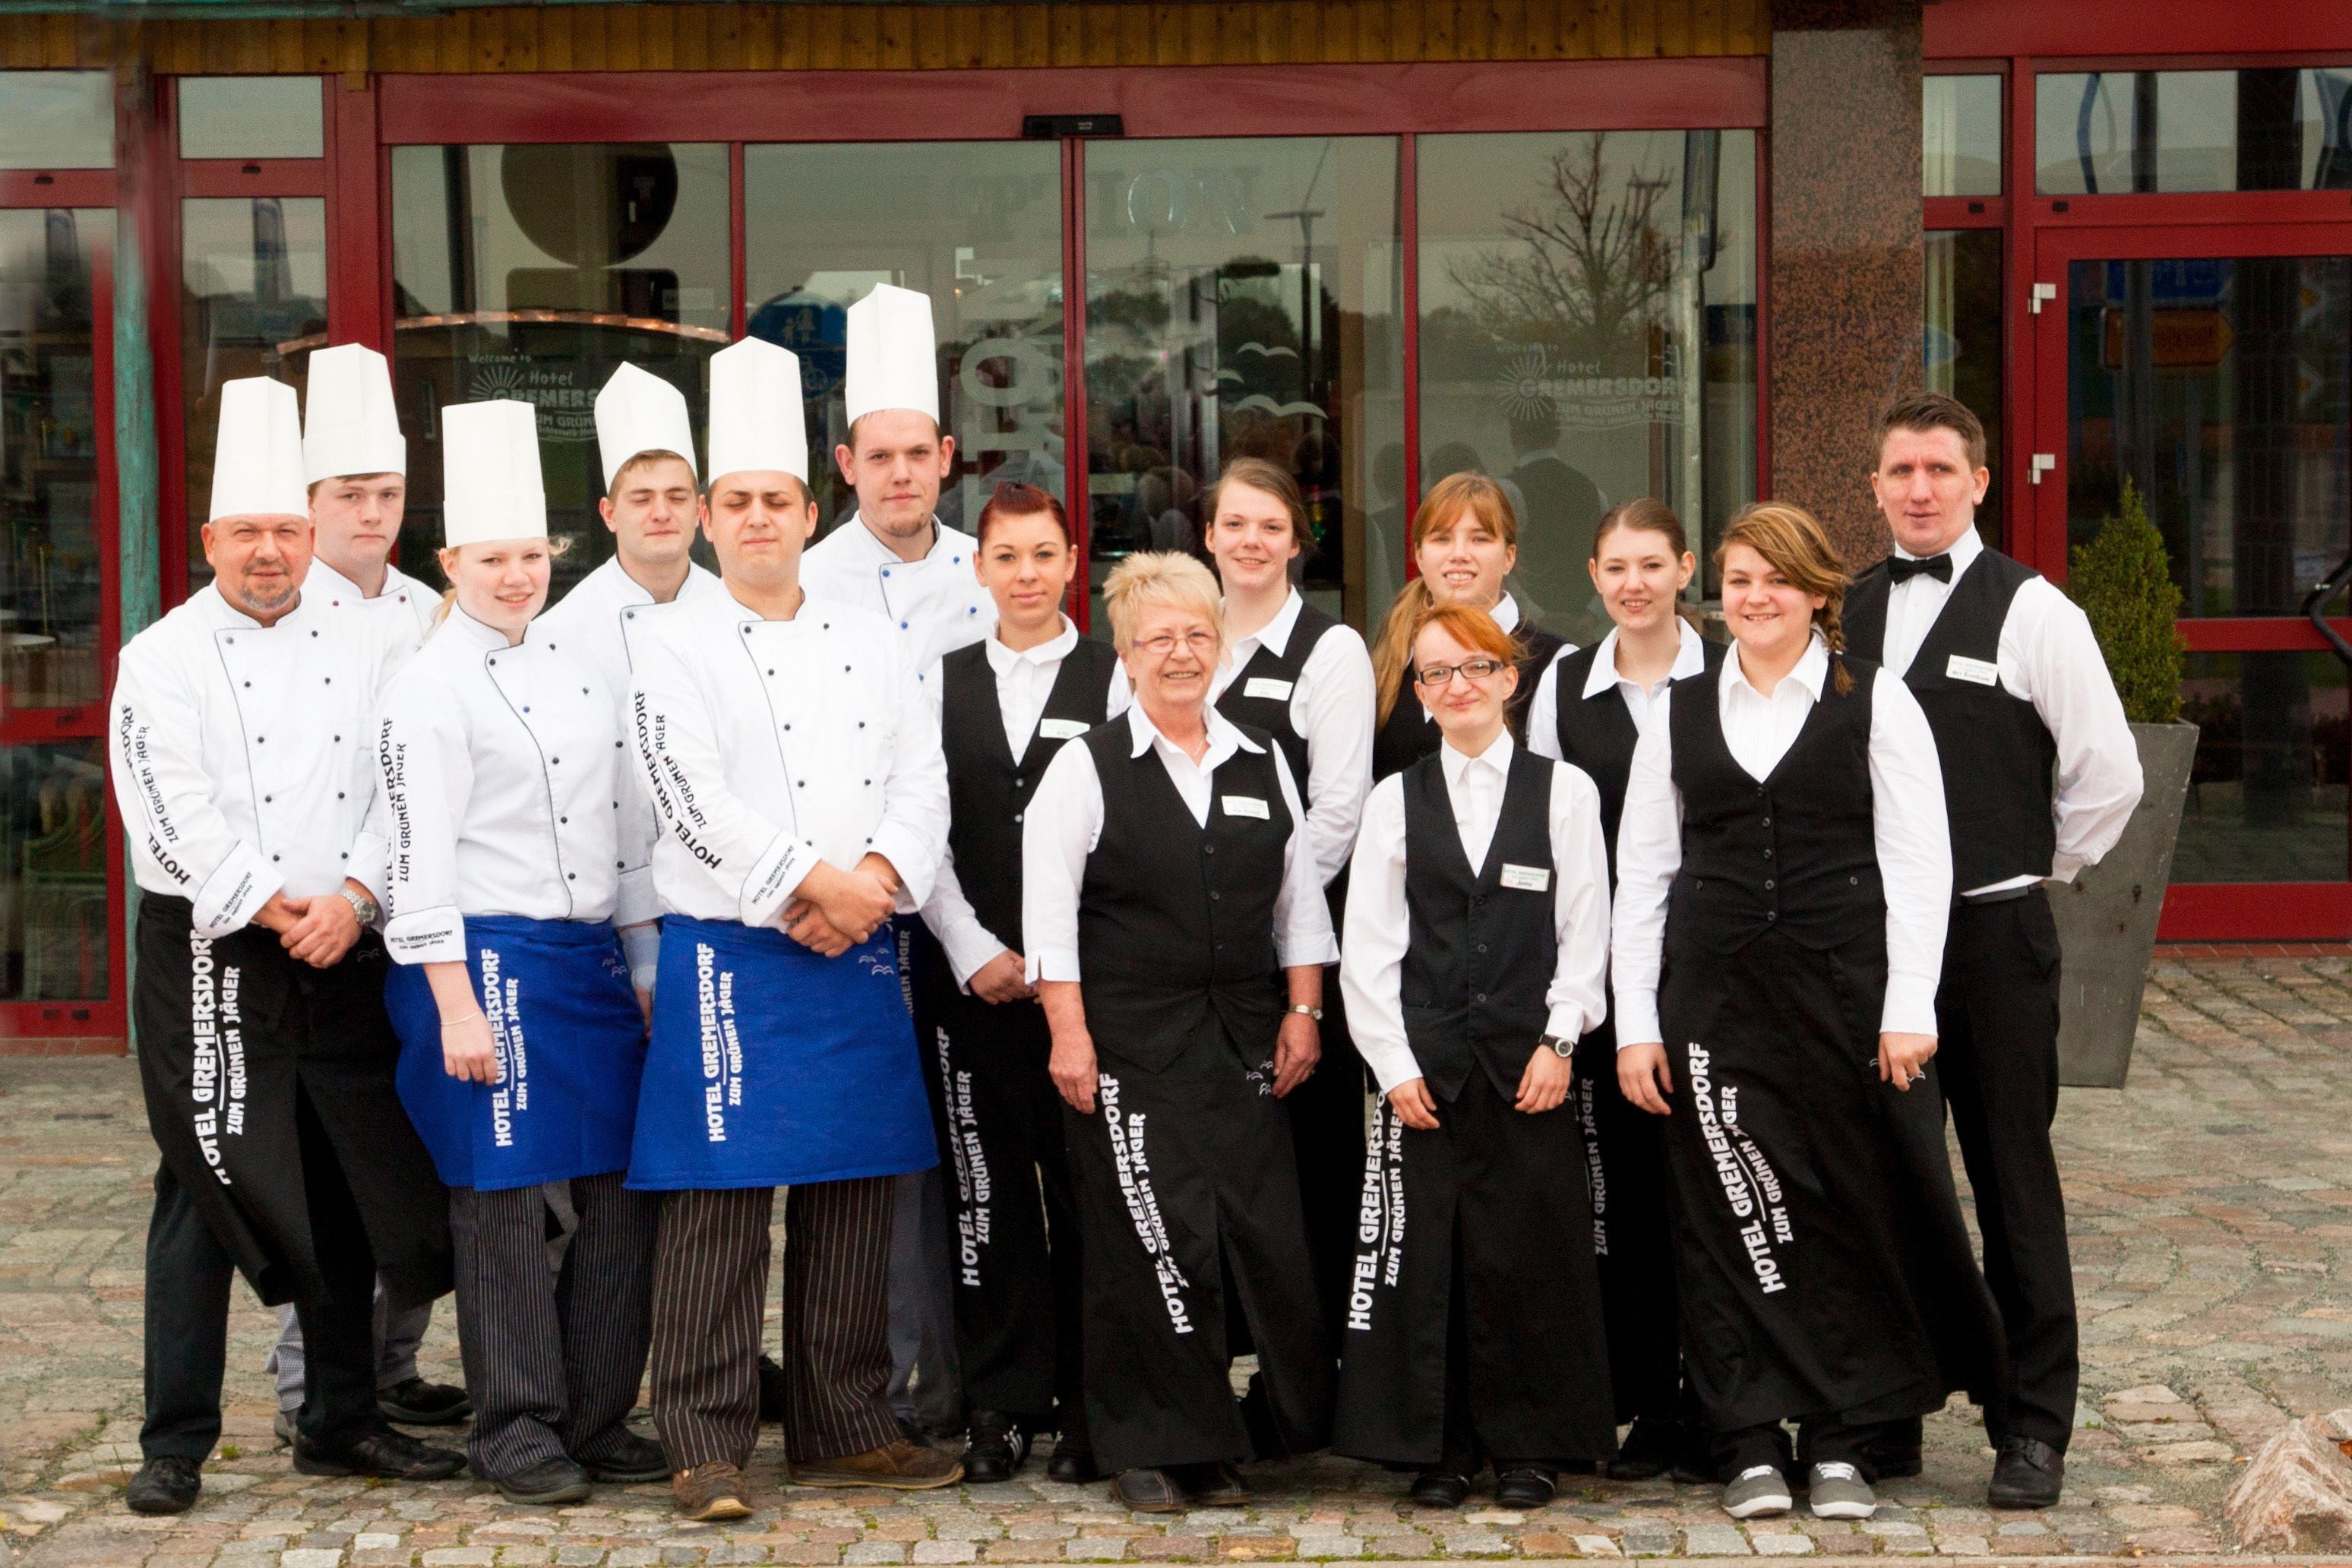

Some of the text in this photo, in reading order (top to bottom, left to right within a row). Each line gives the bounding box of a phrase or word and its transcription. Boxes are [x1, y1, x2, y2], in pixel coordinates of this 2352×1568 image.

[468, 353, 533, 364] Welcome to
[530, 370, 574, 386] Hotel
[1557, 359, 1601, 375] Hotel
[494, 388, 599, 408] GREMERS
[536, 413, 596, 428] UM GRÜN
[134, 726, 180, 843] ZUM GRÜNEN JÄGER
[634, 690, 723, 870] HOTEL GREMERSDORF
[396, 788, 412, 851] GRÜNEN
[146, 831, 191, 885] HOTEL
[399, 854, 410, 882] ZUM
[896, 930, 911, 972] JÄGER
[219, 966, 248, 1136] ZUM GRÜNEN JÄGER
[505, 978, 528, 1111] ZUM GRÜNEN JÄGER
[697, 942, 727, 1143] HOTEL GREMERSDORF
[717, 972, 743, 1107] ZUM GRÜNEN JÄGER
[492, 1088, 514, 1147] HOTEL
[1128, 1113, 1150, 1174] JÄGER
[936, 1026, 981, 1287] HOTEL GREMERSDORF
[956, 1070, 991, 1246] ZUM GRÜNEN JÄGER
[1580, 1077, 1608, 1256] ZUM GRÜNEN JÄGER
[1688, 1042, 1787, 1295] HOTEL GREMERSDORF
[1739, 1140, 1782, 1203] GRÜNEN
[1099, 1073, 1194, 1334] HOTEL GREMERSDORF
[1138, 1178, 1171, 1251] GRÜNEN
[1347, 1090, 1386, 1331] HOTEL GREMERSDO
[1384, 1108, 1406, 1287] ZUM GRÜNEN JÄGE
[1771, 1206, 1794, 1244] ZUM
